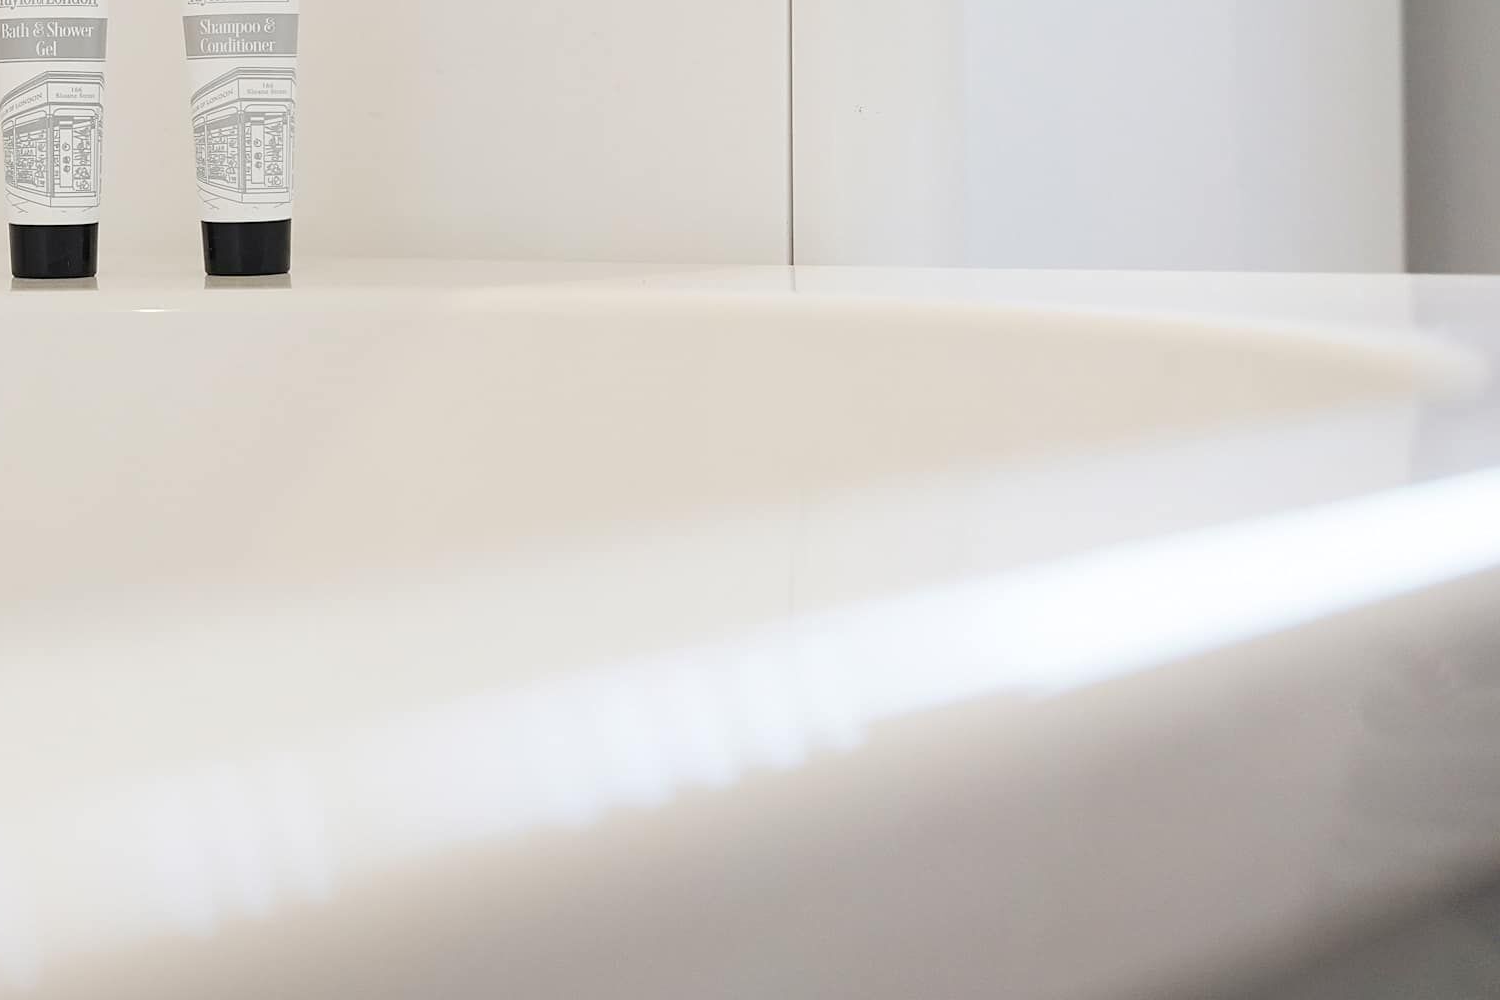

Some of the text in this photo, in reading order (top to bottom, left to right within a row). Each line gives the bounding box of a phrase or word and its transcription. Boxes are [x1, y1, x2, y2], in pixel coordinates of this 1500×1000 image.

[1, 21, 94, 39] Bath & Shower
[200, 17, 275, 38] Shampoo &
[36, 41, 57, 57] Gel
[200, 37, 276, 54] Conditioner
